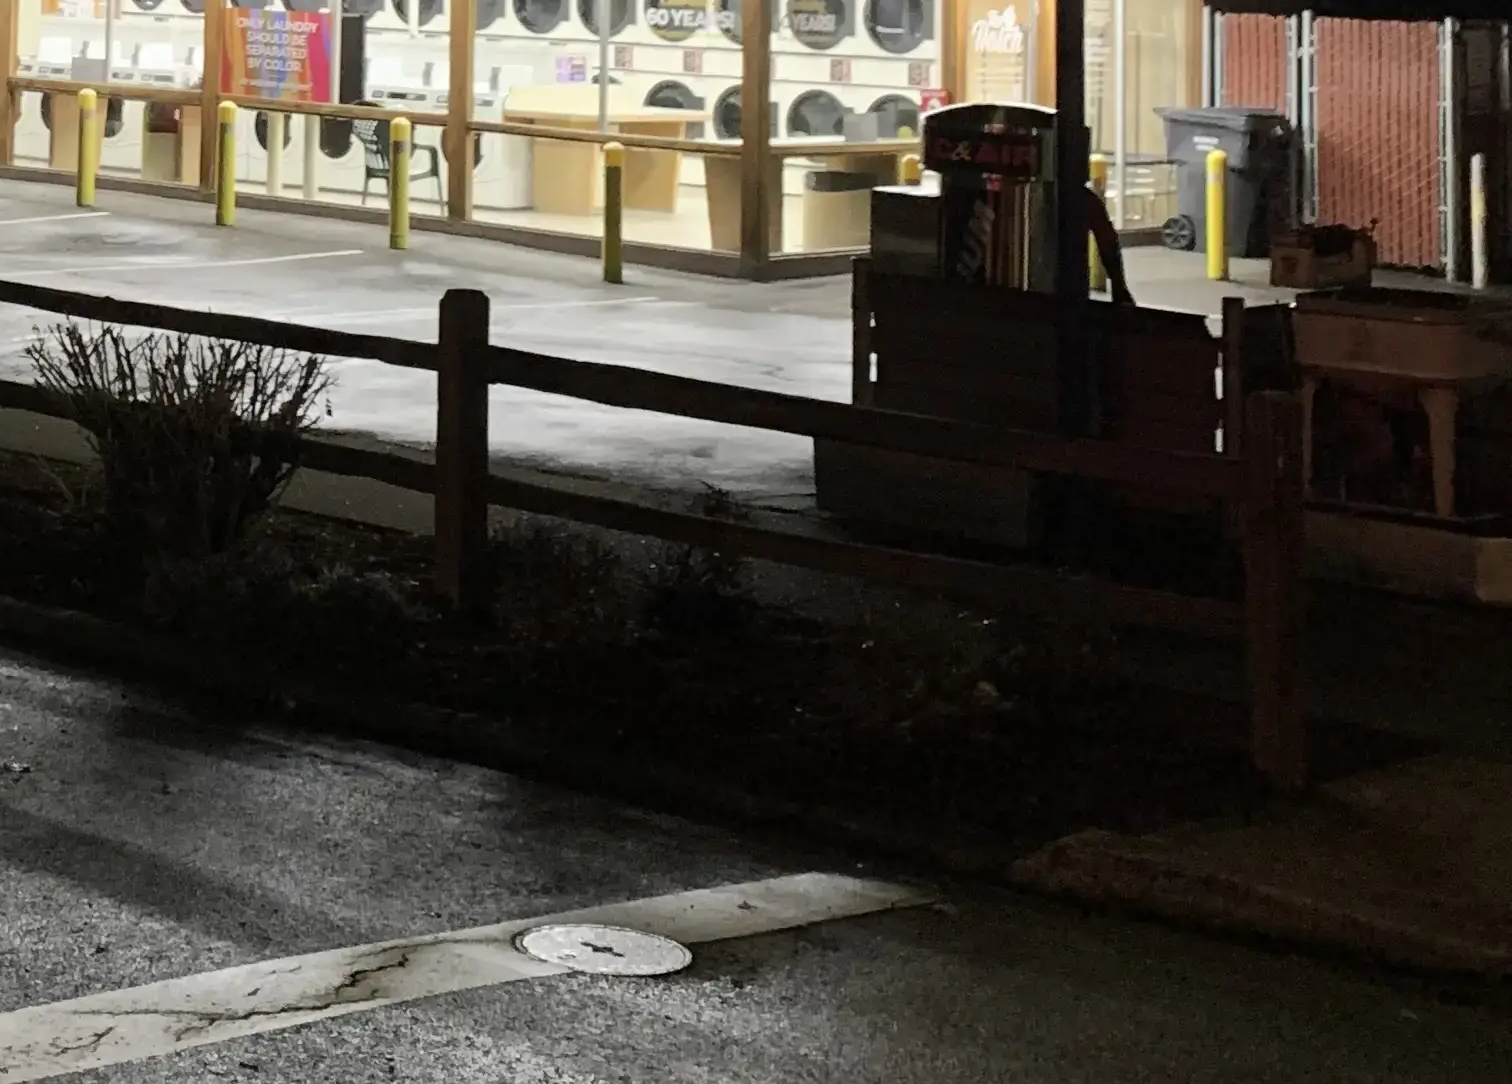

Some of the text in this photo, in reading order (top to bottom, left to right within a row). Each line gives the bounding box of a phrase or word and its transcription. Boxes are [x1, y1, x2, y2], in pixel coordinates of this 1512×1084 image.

[646, 7, 669, 27] 60
[237, 17, 319, 33] ONLY LAUNDRY
[247, 30, 307, 45] SHOULD BE
[246, 44, 307, 59] SEPARATED
[247, 57, 262, 68] BY
